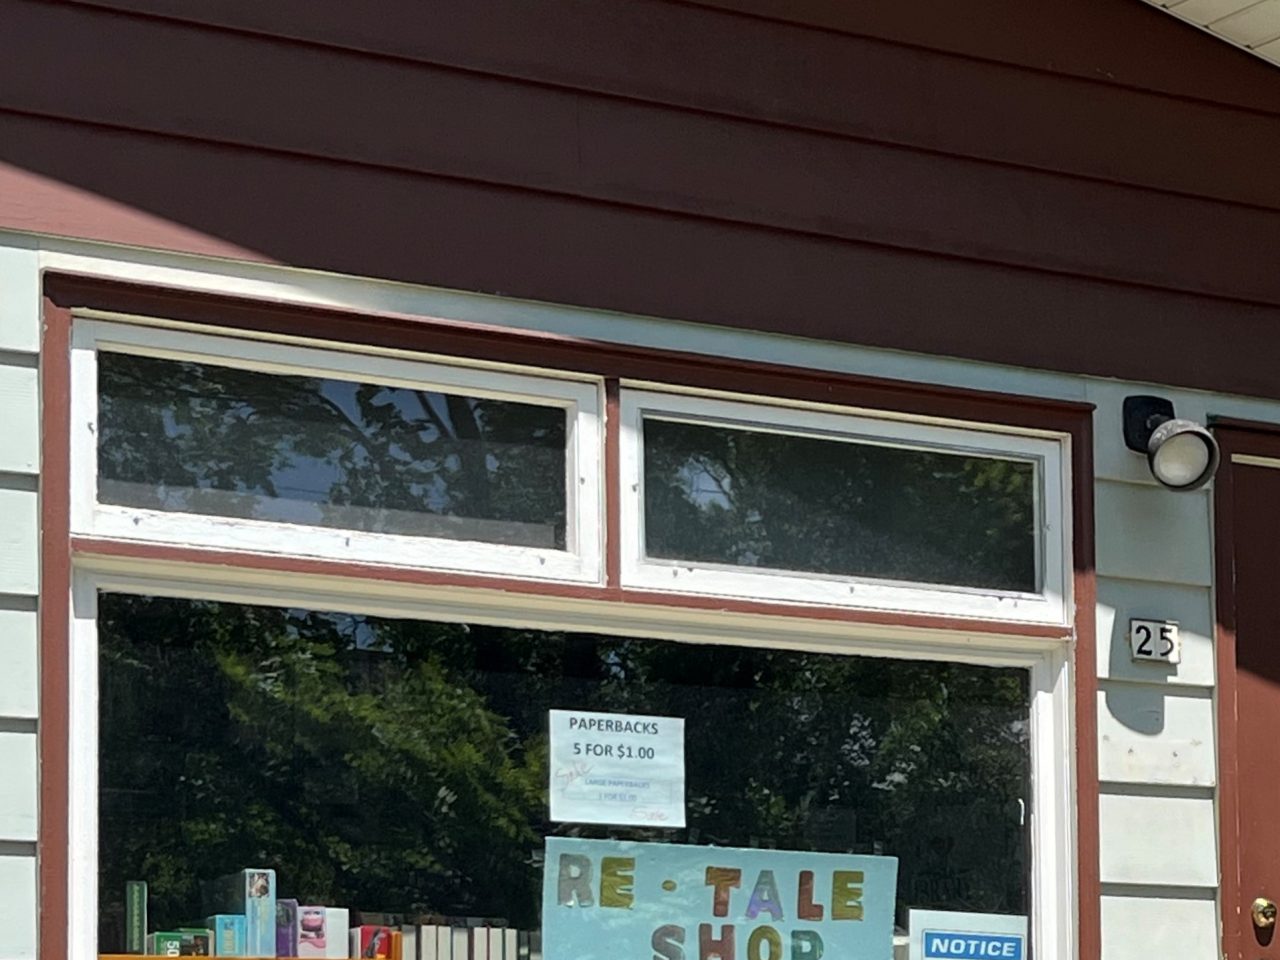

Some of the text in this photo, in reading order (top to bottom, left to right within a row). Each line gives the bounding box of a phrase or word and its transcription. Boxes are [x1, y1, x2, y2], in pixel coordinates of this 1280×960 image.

[1135, 624, 1174, 657] 25
[569, 717, 659, 735] PAPERBACKS
[573, 742, 655, 760] 5 FOR $1.00
[607, 779, 651, 789] PAPERBACKS
[166, 940, 180, 958] 50
[931, 938, 1017, 957] NOTICE
